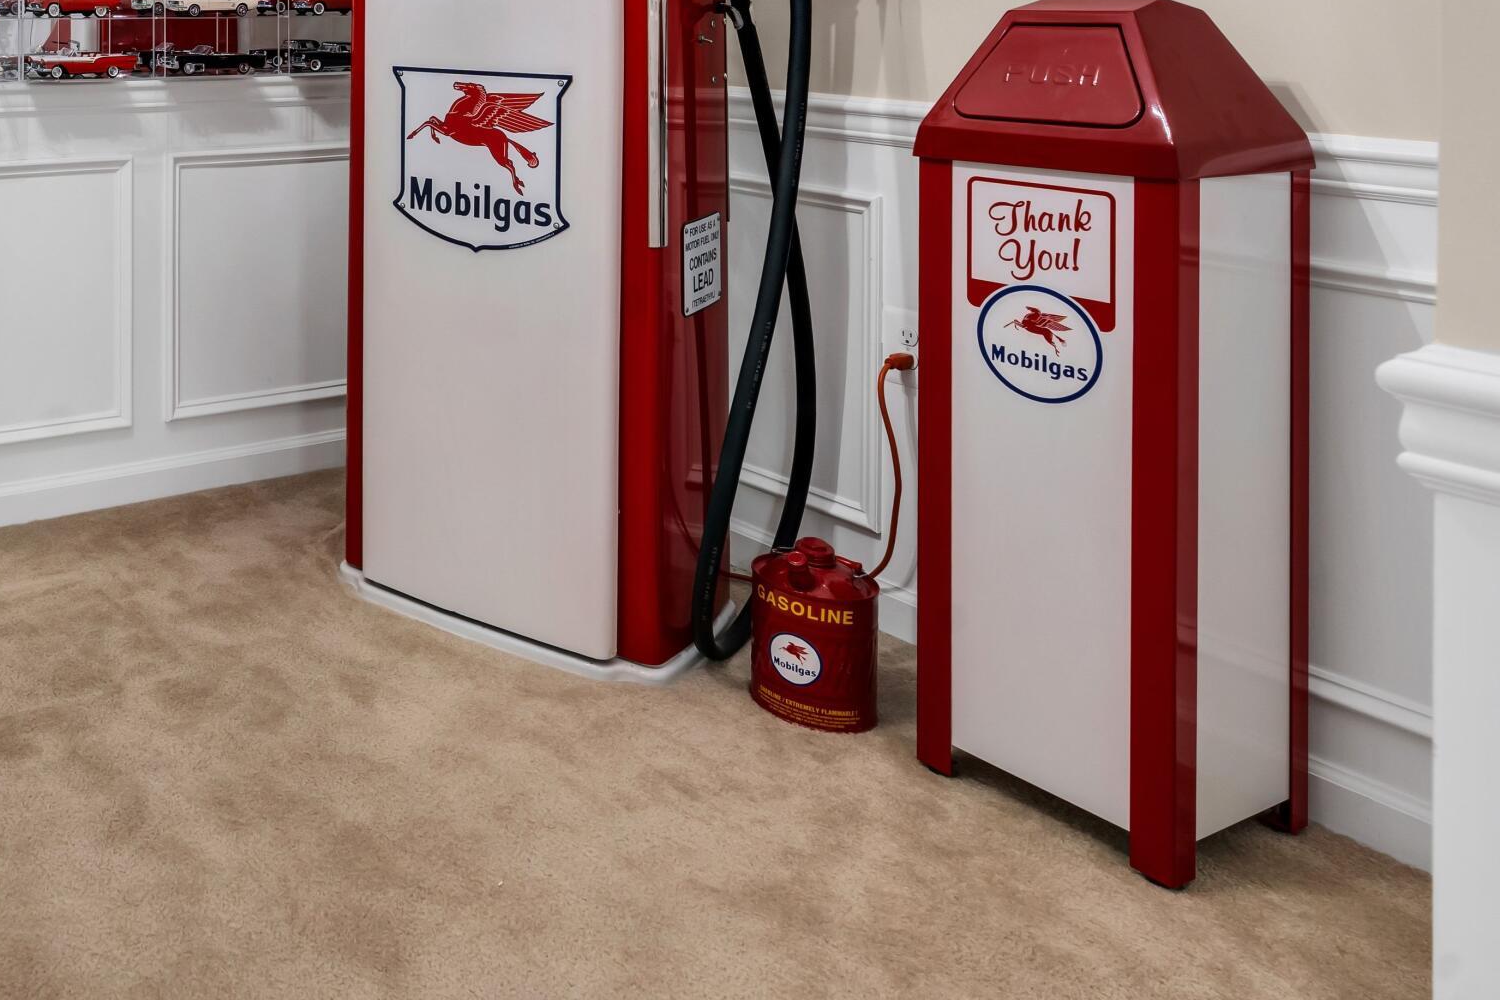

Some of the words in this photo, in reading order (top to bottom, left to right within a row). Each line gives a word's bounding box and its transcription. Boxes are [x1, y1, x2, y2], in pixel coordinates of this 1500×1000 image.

[1003, 63, 1101, 87] PUSH
[410, 176, 553, 233] Mobilgas
[689, 226, 699, 238] FOR
[699, 223, 707, 234] USE
[707, 221, 713, 230] AS
[988, 199, 1092, 237] Thank
[685, 239, 700, 252] MOTOR
[700, 235, 710, 246] FUEL
[689, 248, 717, 271] CONTAINS
[998, 238, 1080, 281] You!
[693, 268, 714, 293] LEAD
[991, 343, 1089, 382] Mobilgas
[757, 584, 853, 625] GASOLINE
[773, 656, 817, 677] Mobilgas
[785, 698, 820, 714] EXTREMELY
